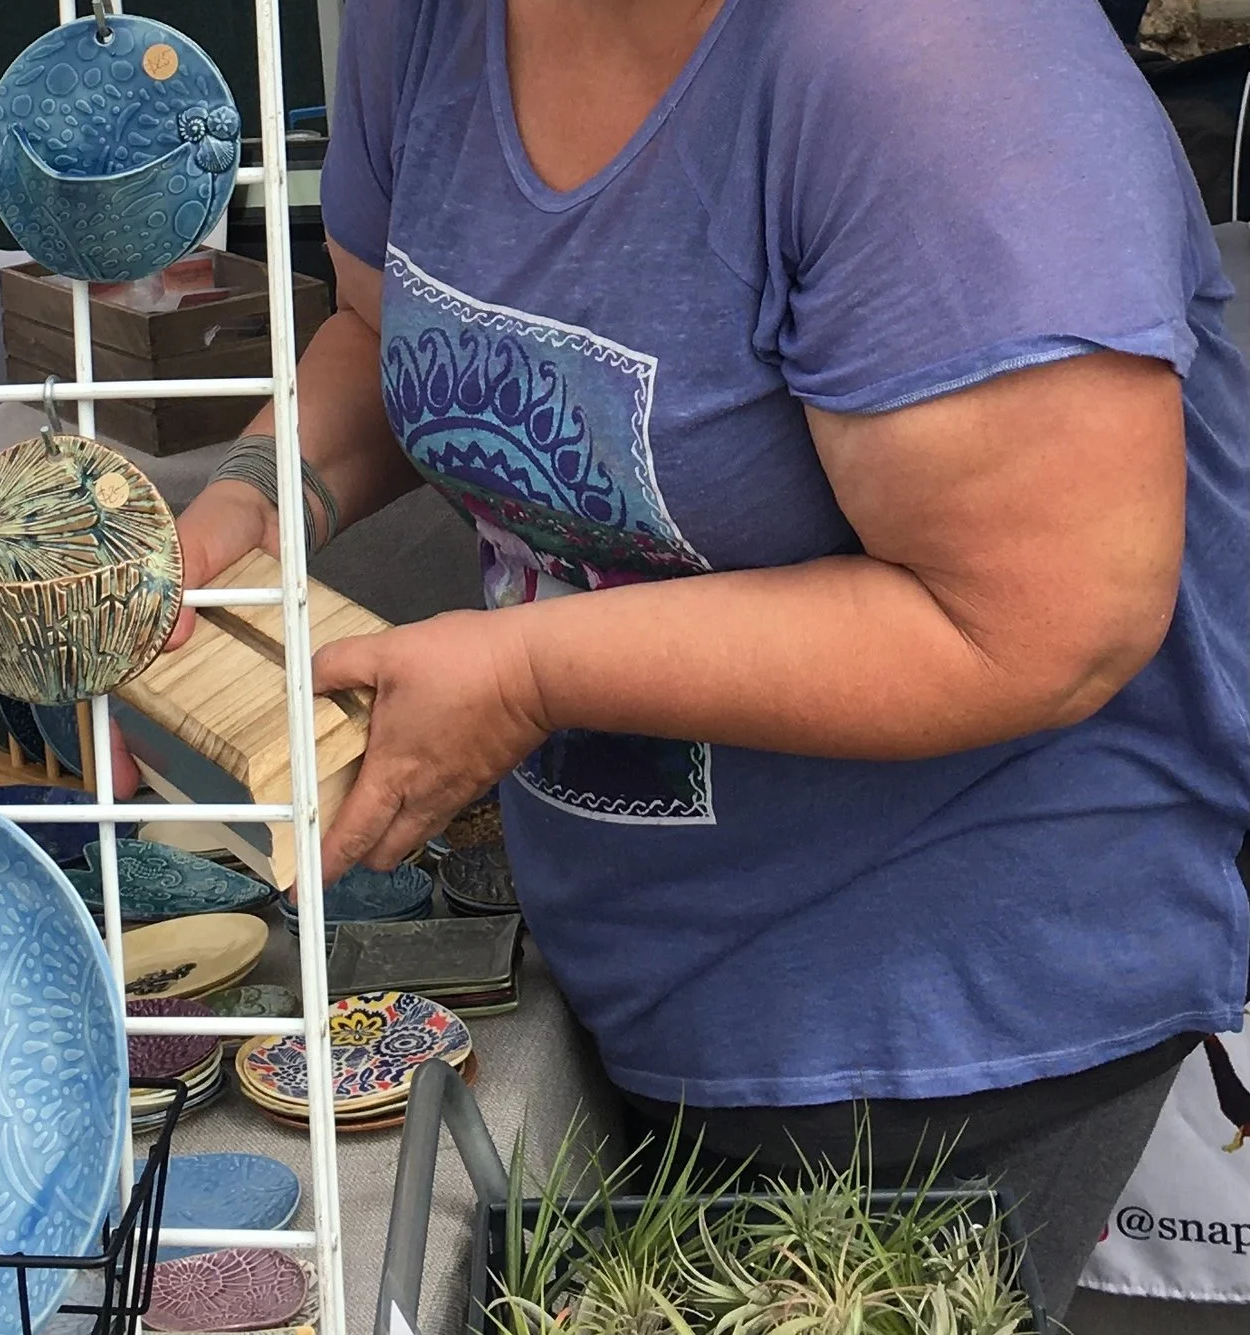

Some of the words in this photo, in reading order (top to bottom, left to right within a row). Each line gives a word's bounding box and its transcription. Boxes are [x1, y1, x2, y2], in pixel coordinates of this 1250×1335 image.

[148, 49, 172, 74] $25
[97, 482, 126, 504] $25
[1116, 1206, 1250, 1255] @snap
